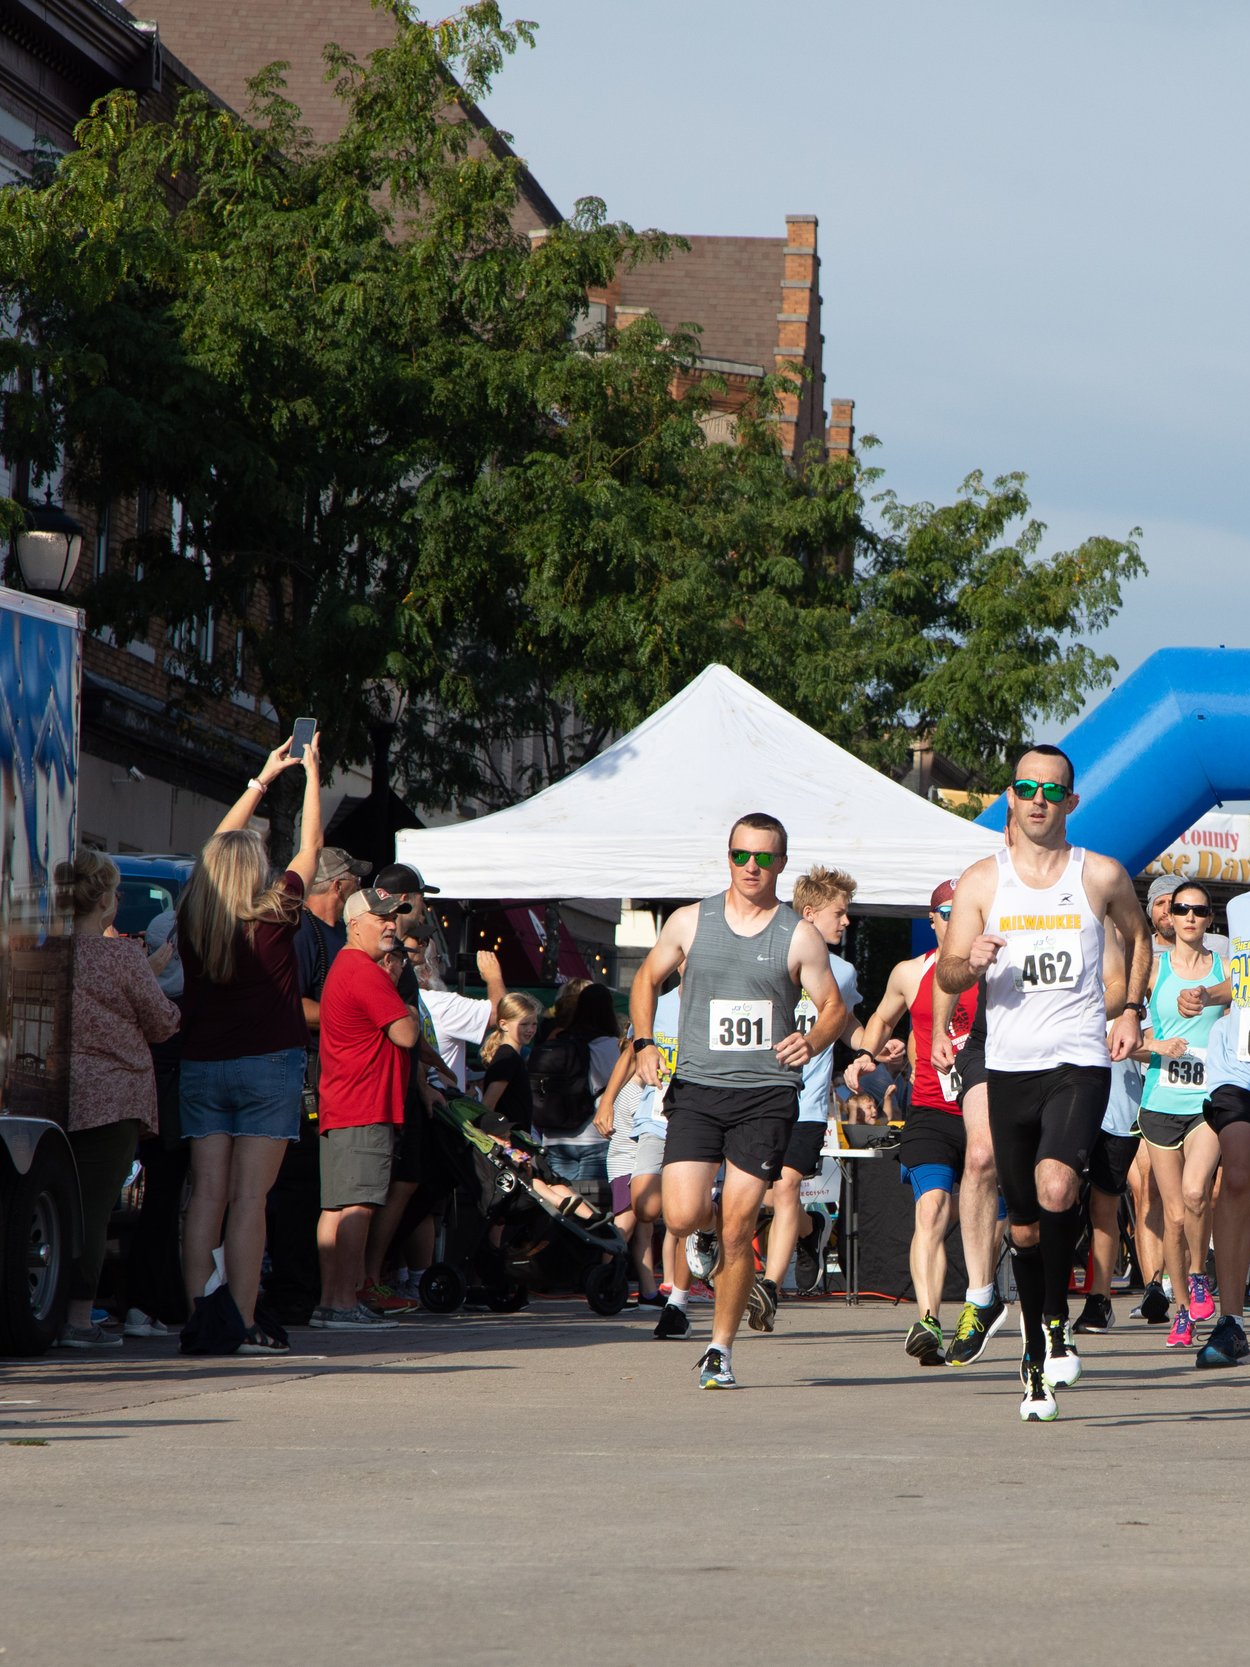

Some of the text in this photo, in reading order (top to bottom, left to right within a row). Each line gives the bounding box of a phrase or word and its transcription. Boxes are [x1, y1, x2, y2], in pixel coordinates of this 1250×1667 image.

[999, 913, 1082, 932] MILWAUKEE
[1022, 950, 1074, 986] 462
[719, 1017, 764, 1046] 391
[1168, 1060, 1205, 1086] 638
